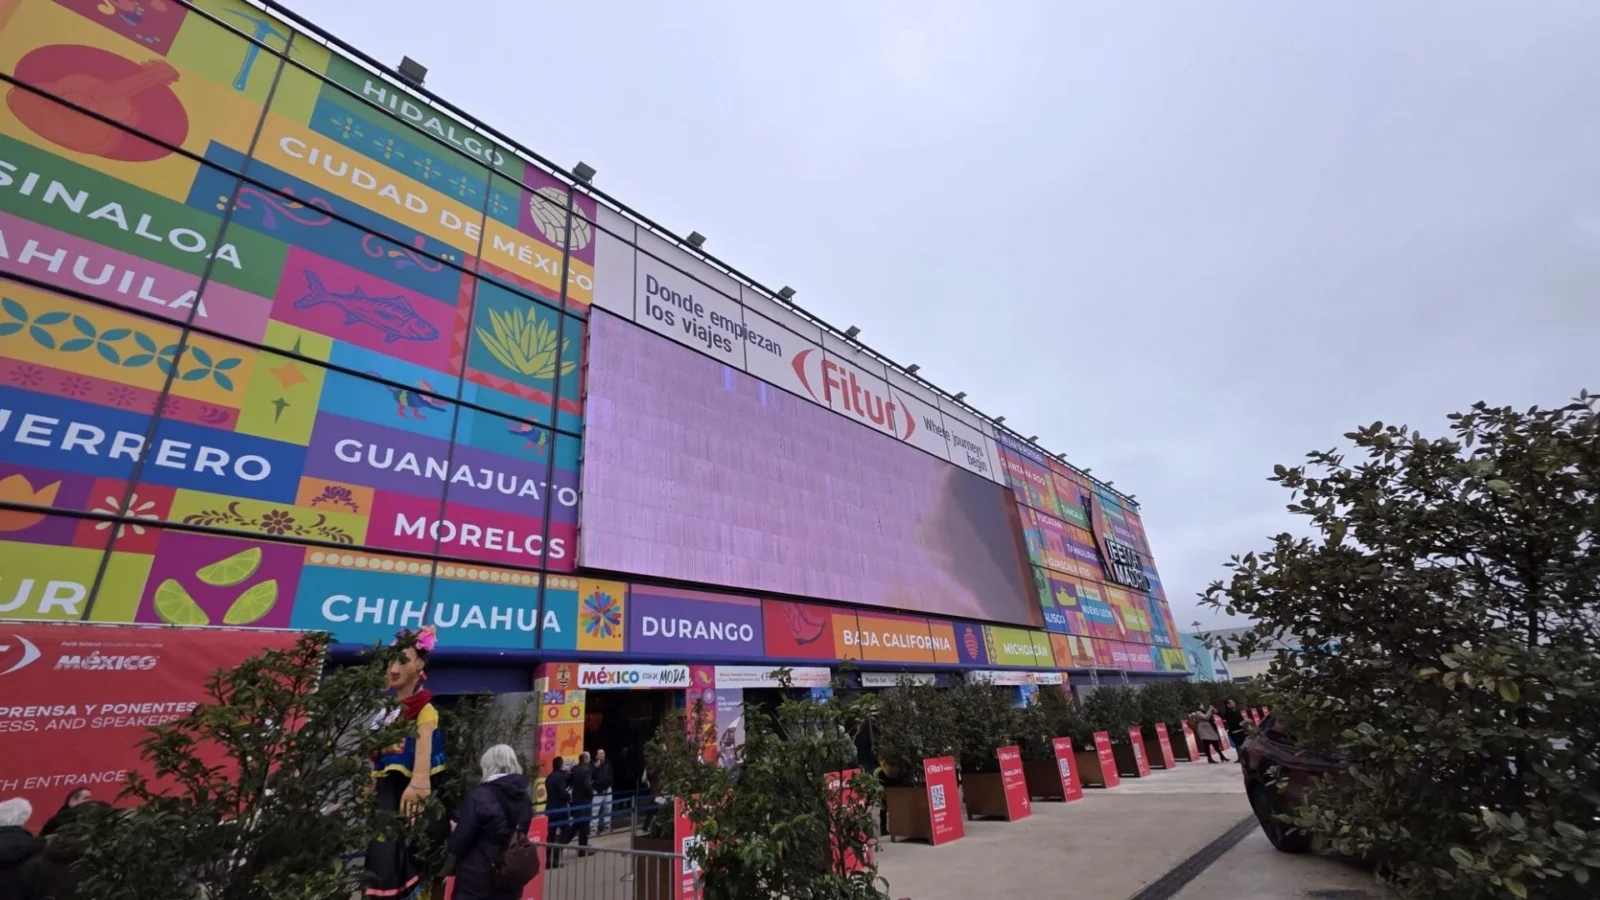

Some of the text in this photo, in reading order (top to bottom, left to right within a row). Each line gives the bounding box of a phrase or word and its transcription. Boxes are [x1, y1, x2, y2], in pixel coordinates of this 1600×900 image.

[363, 79, 504, 166] HIDALGO
[279, 136, 428, 214] CIUDAD
[439, 209, 481, 242] DE
[645, 295, 732, 353] los viajes
[646, 273, 783, 357] Donde empiezan
[820, 359, 896, 431] Fitur
[0, 408, 271, 481] ERRERO
[923, 415, 984, 458] Where journeys
[966, 450, 988, 472] begin
[393, 513, 566, 559] MORELOS
[321, 595, 562, 633] CHIHUAHUA
[642, 615, 754, 643] DURANGO
[843, 629, 952, 652] BAJA CALIFORNIA
[53, 650, 157, 671] MÉXICO
[582, 666, 640, 685] MÉXICO
[659, 668, 686, 684] MODA
[45, 718, 86, 731] AND
[85, 705, 97, 716] Y
[24, 770, 127, 789] ENTRANCE
